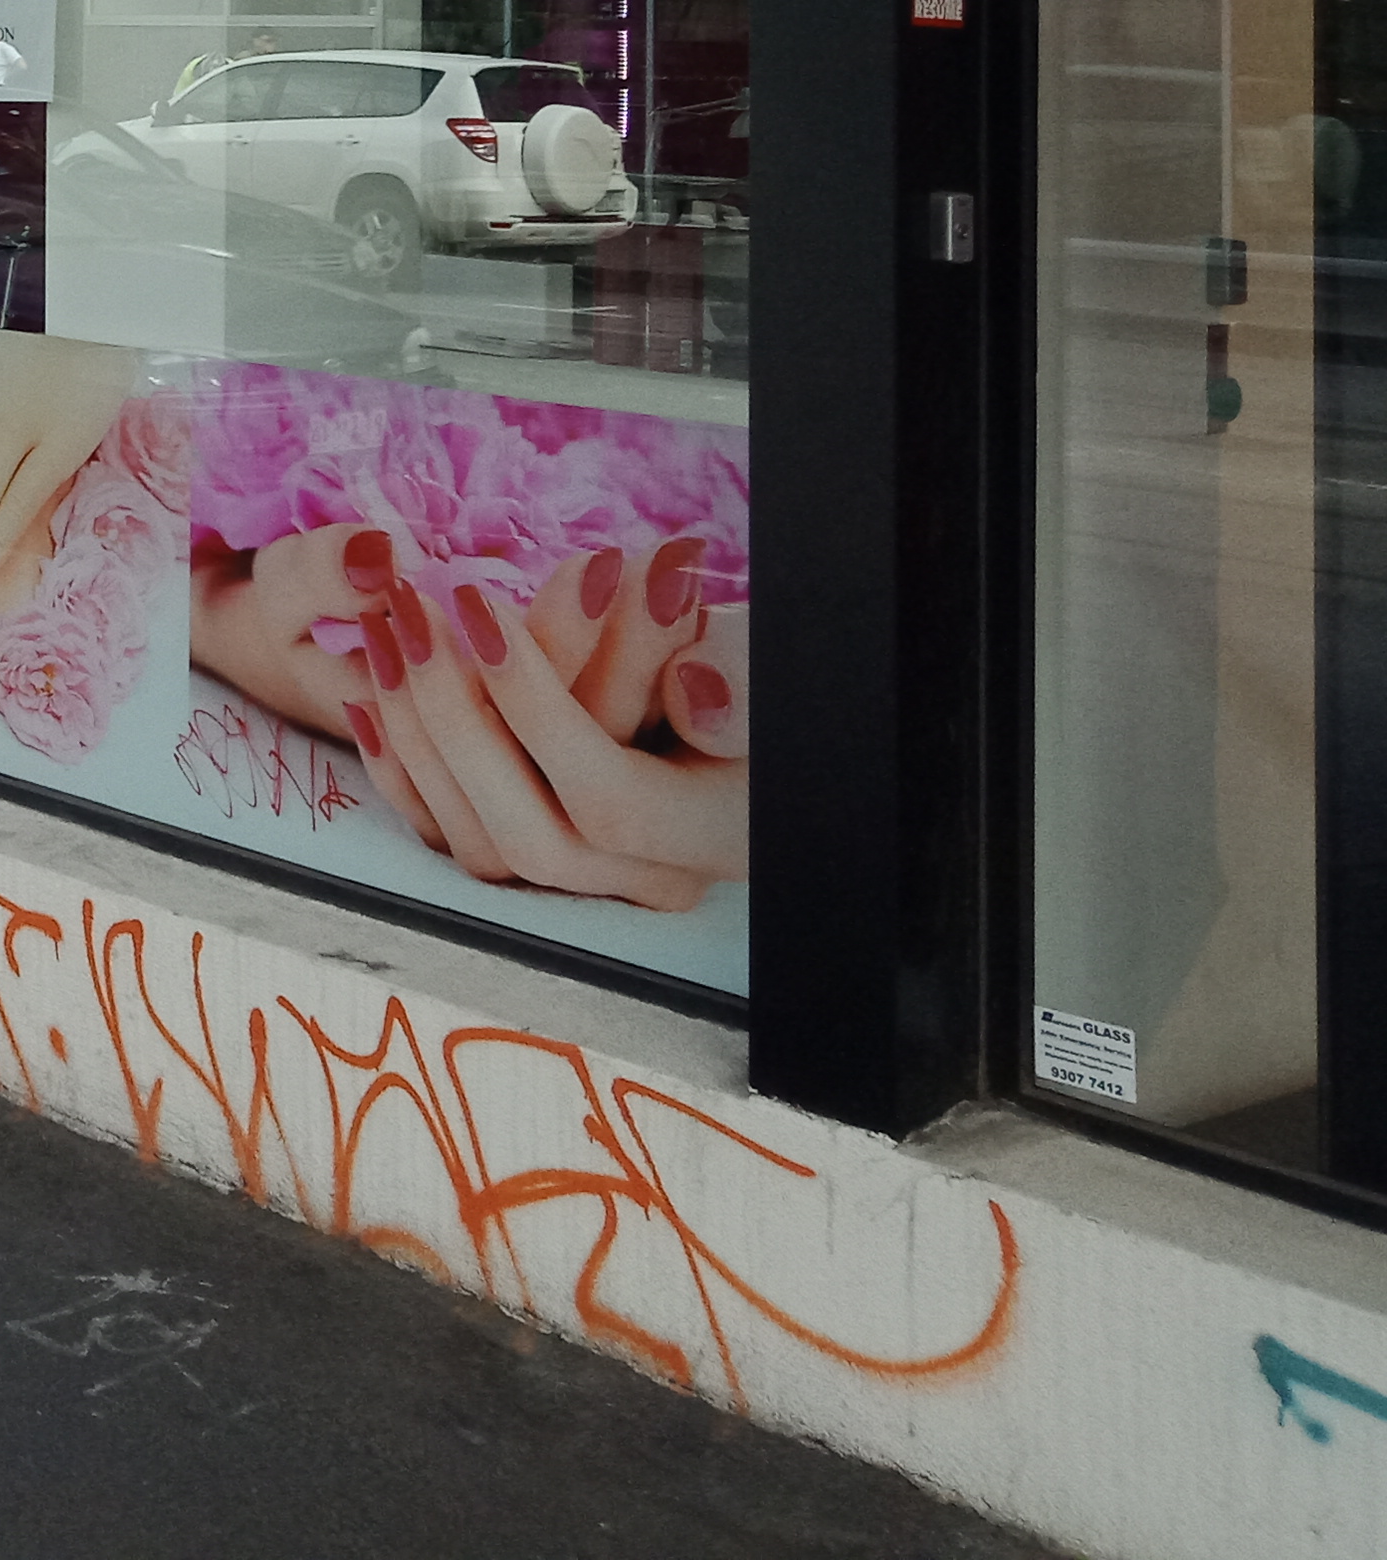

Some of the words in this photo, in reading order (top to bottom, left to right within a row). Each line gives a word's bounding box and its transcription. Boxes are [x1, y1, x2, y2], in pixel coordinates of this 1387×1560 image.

[1083, 1022, 1131, 1044] GLASS
[1050, 1066, 1084, 1085] 9307
[1088, 1077, 1124, 1097] 7412
